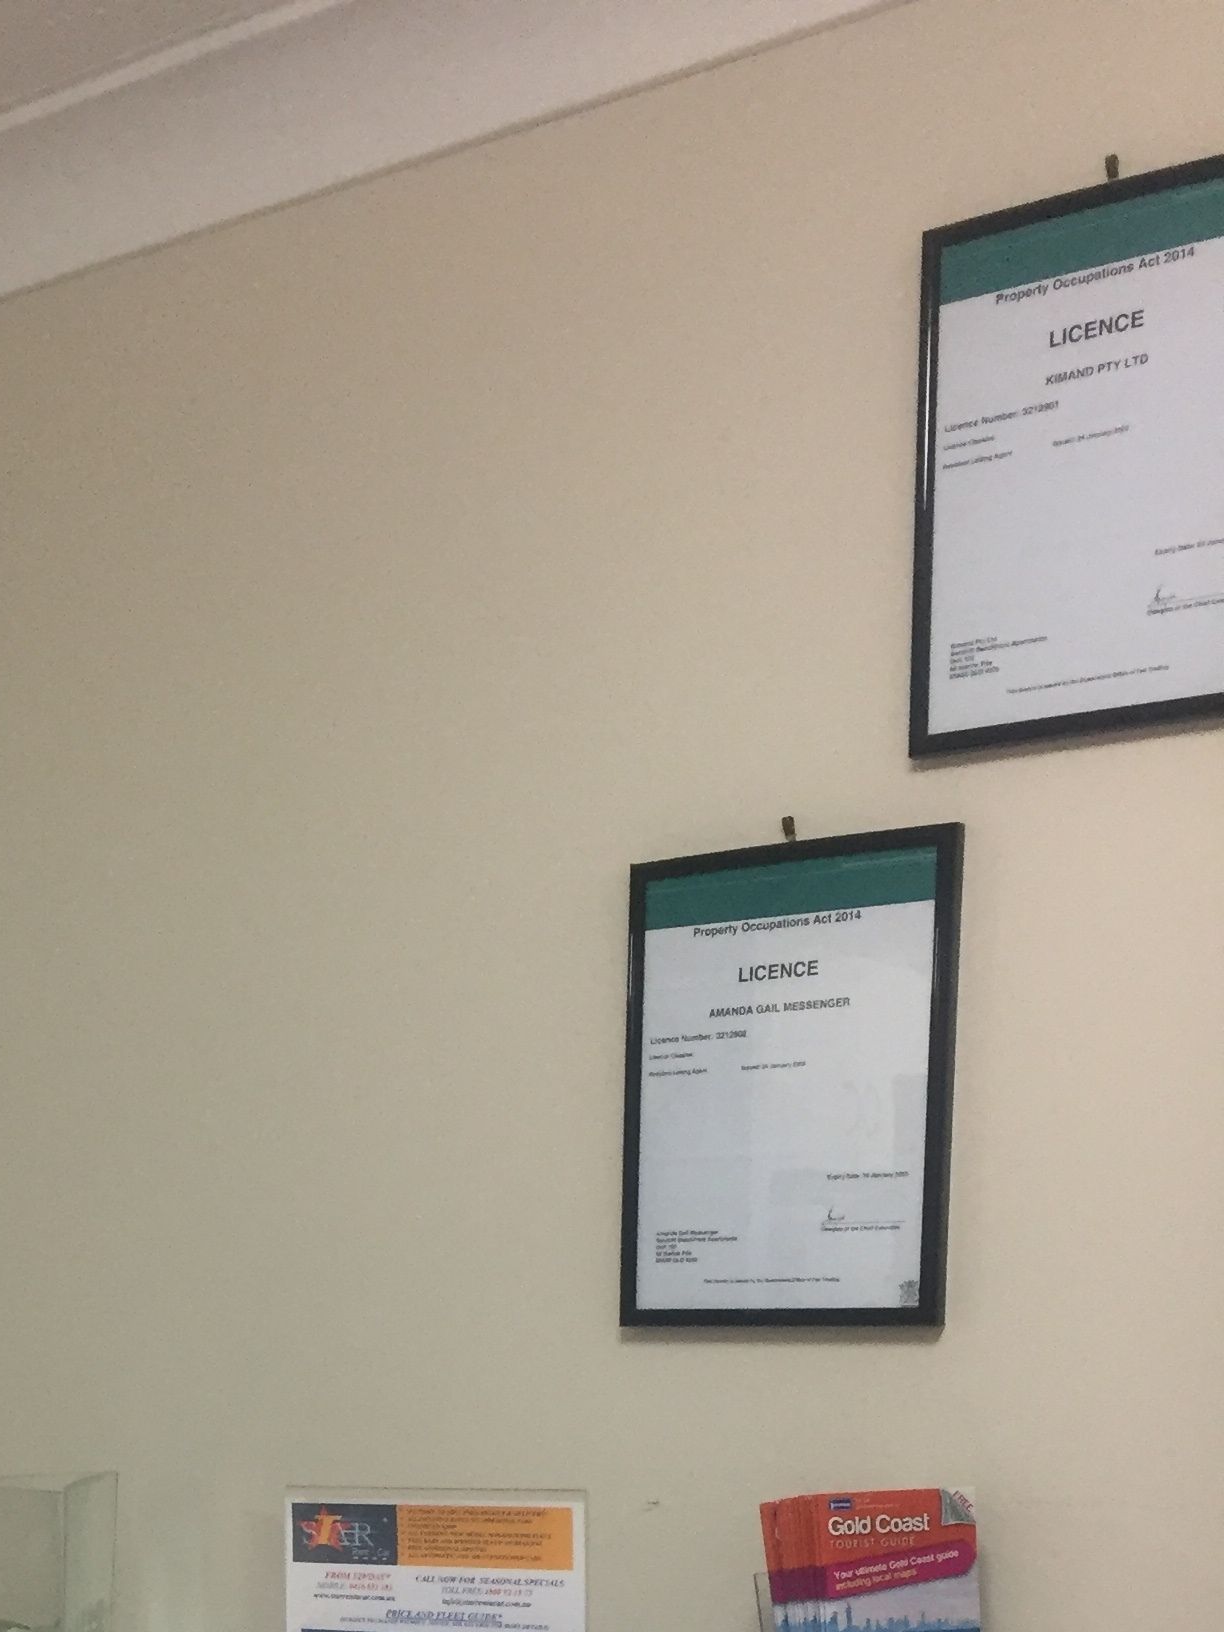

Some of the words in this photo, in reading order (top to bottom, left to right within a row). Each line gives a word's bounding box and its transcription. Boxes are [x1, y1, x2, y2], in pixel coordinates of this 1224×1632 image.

[995, 283, 1049, 305] Property
[1053, 263, 1134, 291] Occupations
[1138, 254, 1161, 269] Act
[1163, 246, 1196, 263] 2014
[1049, 309, 1146, 348] LICENCE
[1045, 366, 1094, 386] KIMAND
[1097, 360, 1121, 374] PTY
[1124, 353, 1149, 368] LTD
[693, 923, 738, 938] Property
[741, 915, 811, 934] Occupations
[813, 912, 833, 925] Act
[835, 909, 862, 922] 2014
[738, 960, 819, 983] LICENCE
[709, 1005, 753, 1019] AMANDA
[756, 1001, 780, 1014] GAIL
[783, 997, 851, 1012] MESSENGER
[828, 1515, 871, 1536] Gold
[875, 1513, 930, 1533] Coast
[830, 1538, 876, 1549] TOURIST
[880, 1536, 915, 1548] GUIDE
[833, 1569, 854, 1581] Your
[854, 1562, 887, 1577] ultimate
[889, 1559, 909, 1571] Gold
[910, 1553, 935, 1567] Coast
[936, 1548, 959, 1563] guide
[836, 1576, 871, 1591] including
[872, 1572, 892, 1584] local
[893, 1568, 917, 1582] maps
